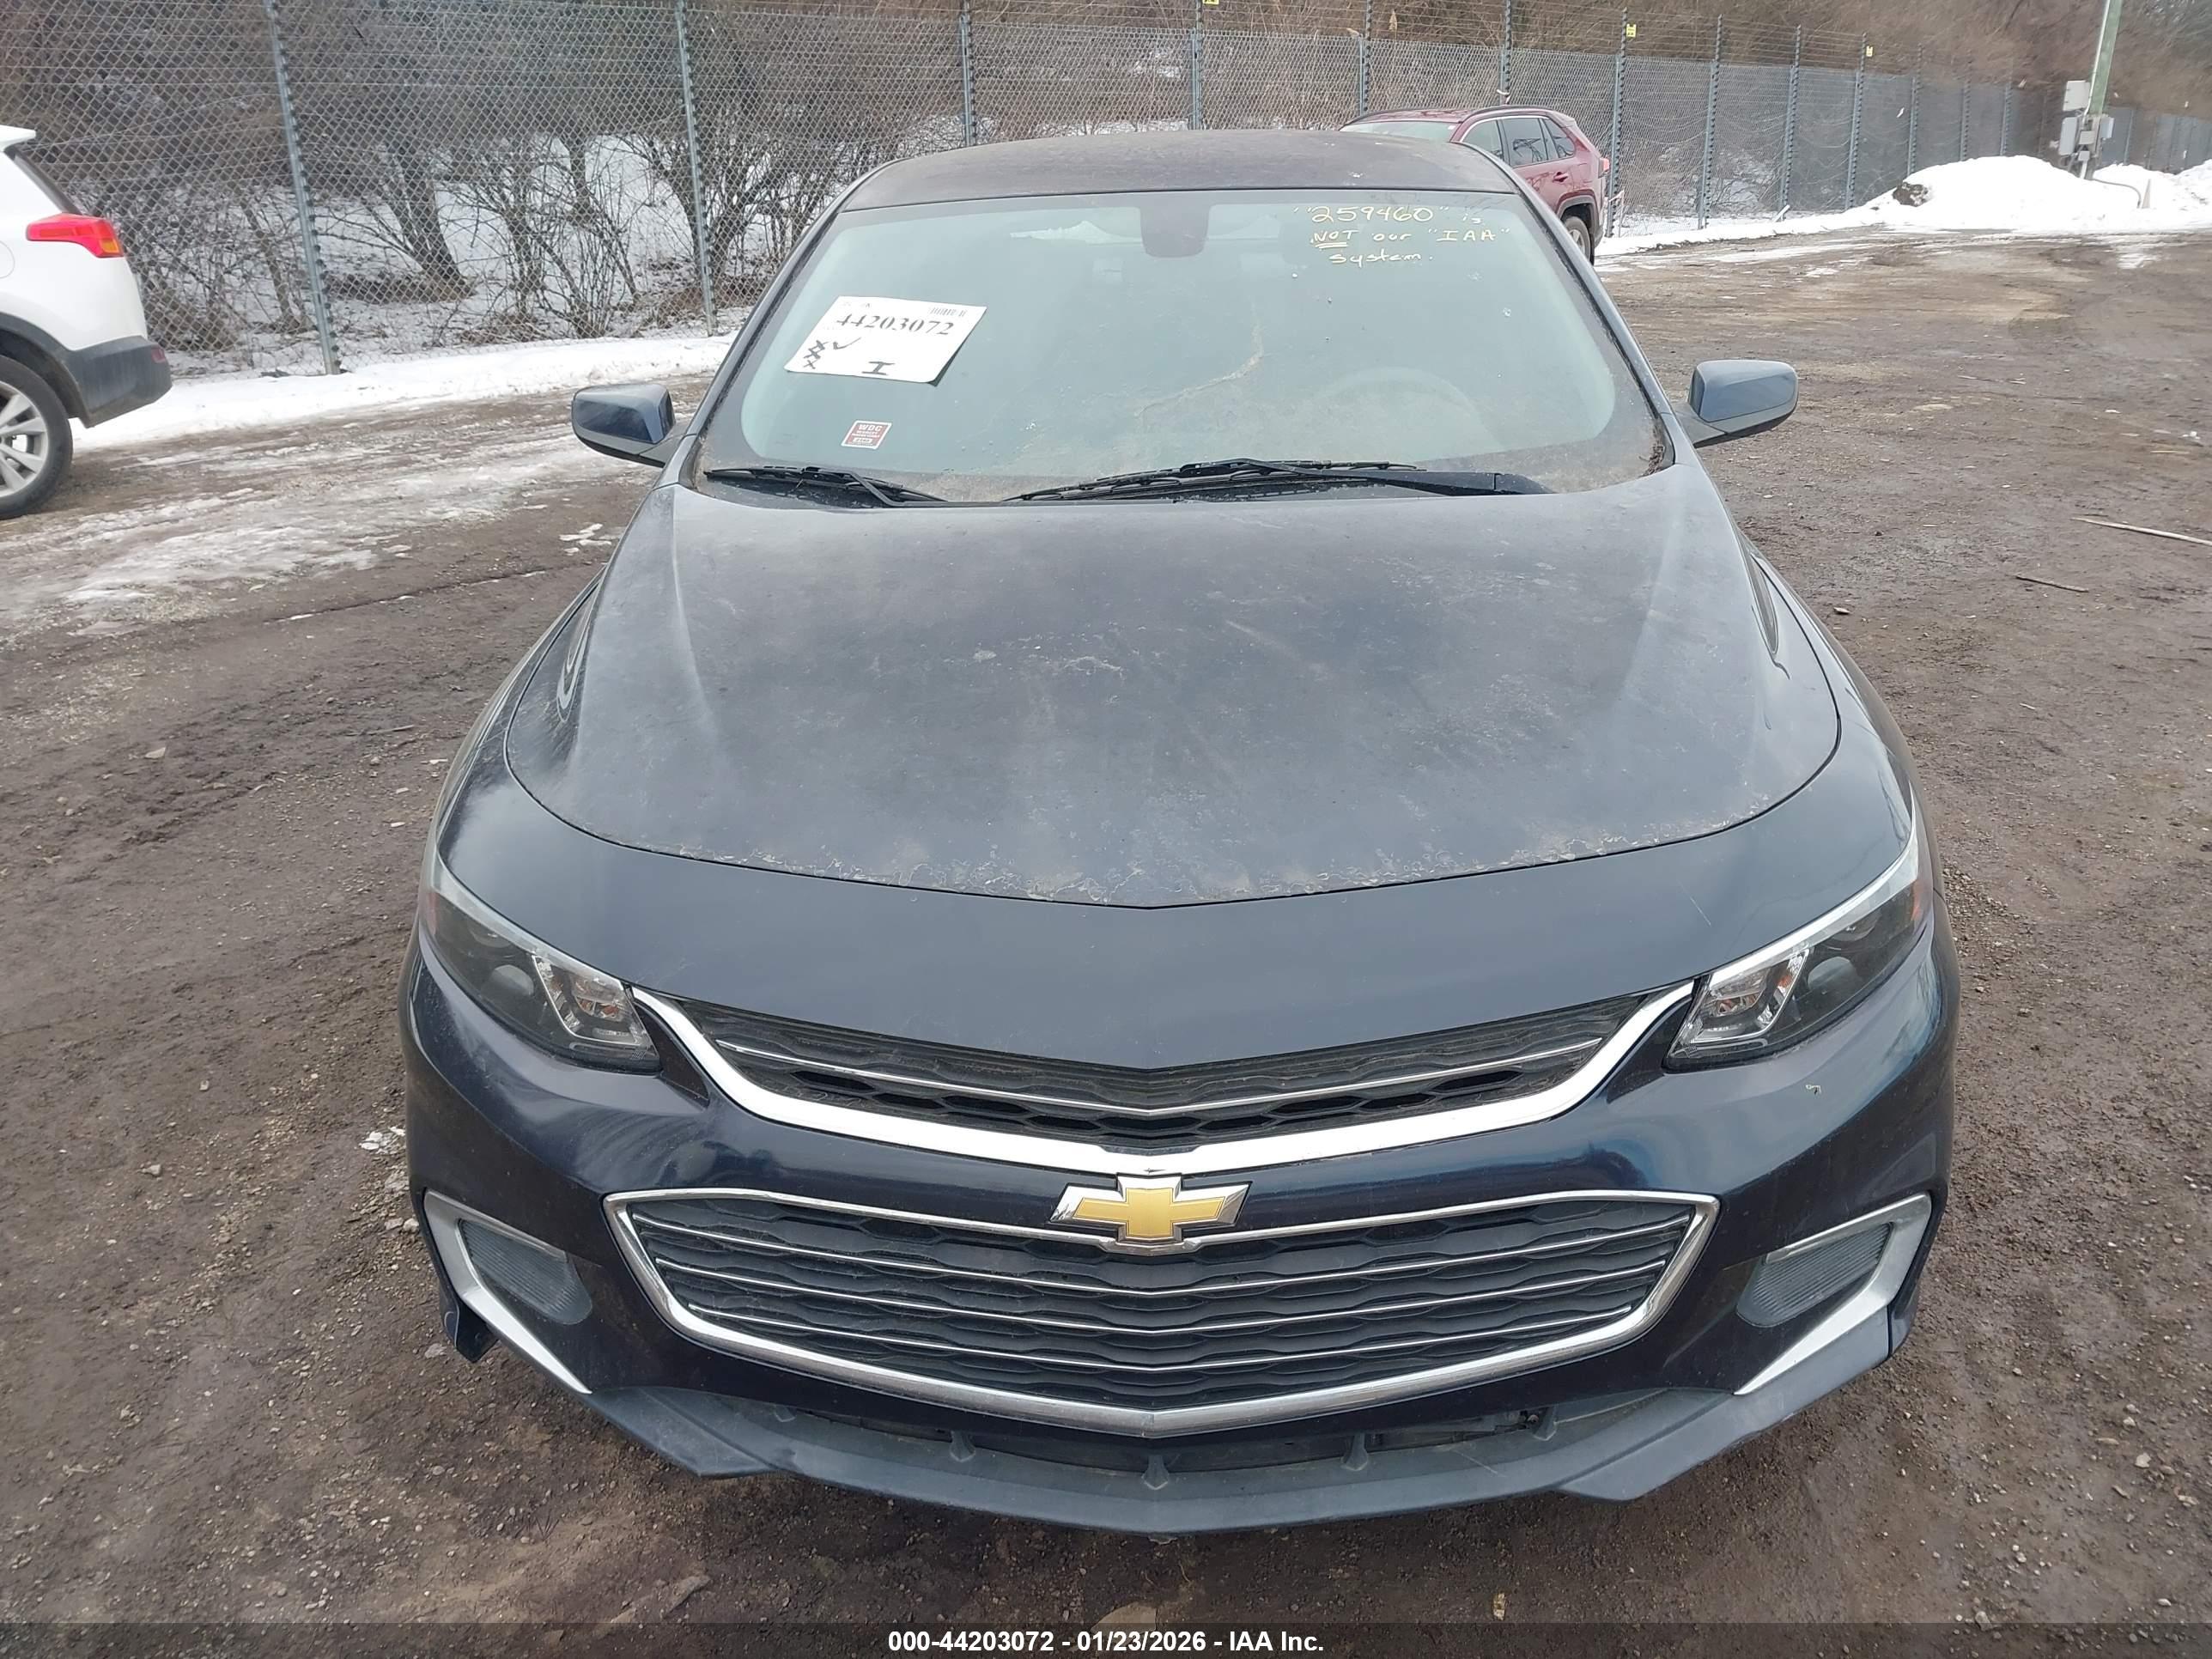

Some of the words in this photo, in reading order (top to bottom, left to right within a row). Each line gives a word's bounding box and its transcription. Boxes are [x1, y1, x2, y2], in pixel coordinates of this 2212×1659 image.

[1313, 229, 1359, 241] NOT
[1373, 232, 1412, 241] our
[836, 313, 954, 336] 44203072
